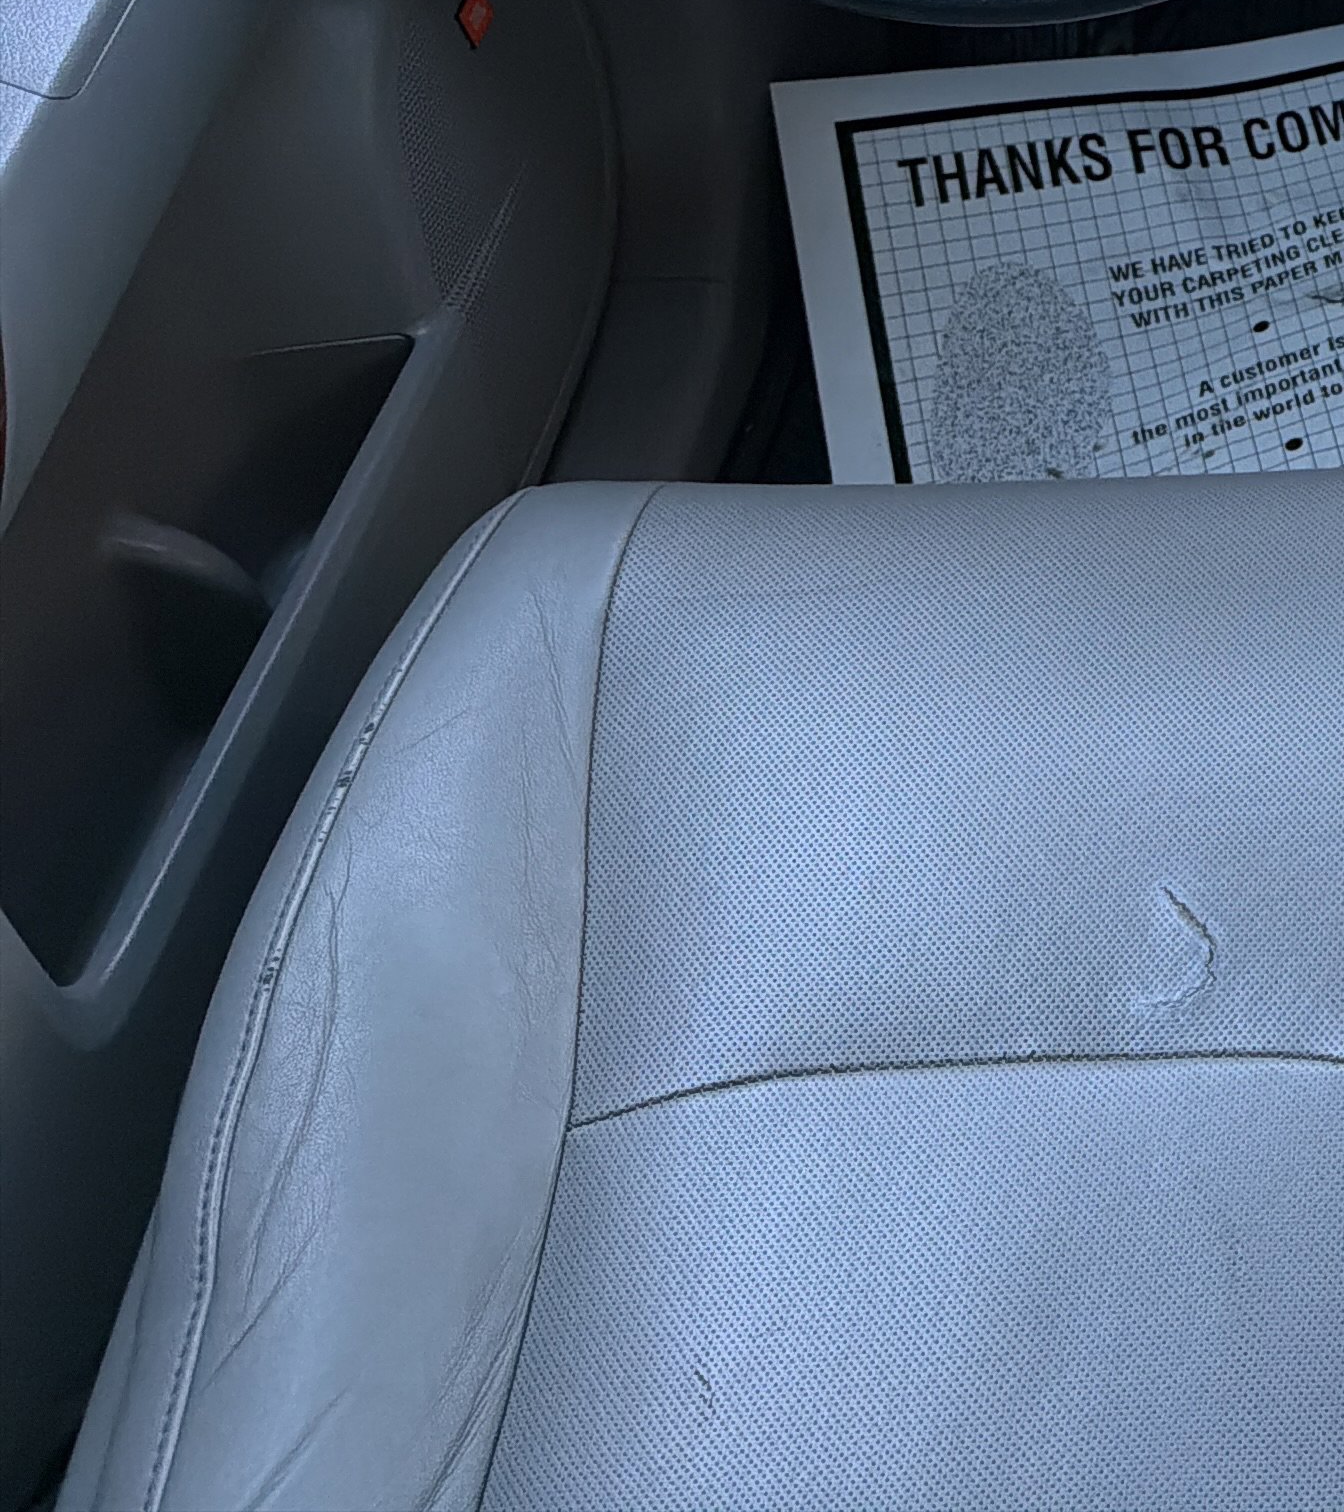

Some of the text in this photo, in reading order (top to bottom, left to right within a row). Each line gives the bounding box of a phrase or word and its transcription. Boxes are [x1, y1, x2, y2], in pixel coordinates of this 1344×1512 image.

[898, 131, 1113, 208] THANKS
[1127, 124, 1230, 175] FOR
[1109, 260, 1145, 283] WE
[1150, 247, 1208, 276] HAVE
[1211, 233, 1275, 264] TRIED
[1278, 220, 1308, 240] TO
[1112, 282, 1176, 308] YOUR
[1182, 246, 1300, 294] CARPETING
[1130, 298, 1190, 329] WITH
[1199, 286, 1245, 315] THIS
[1251, 260, 1318, 294] PAPER
[1132, 423, 1168, 446] the
[1174, 398, 1229, 432] most
[1235, 358, 1343, 408] important
[1199, 380, 1215, 398] A
[1220, 342, 1321, 388] customer
[1184, 434, 1205, 448] in
[1210, 416, 1246, 437] the
[1253, 392, 1316, 422] world
[1320, 382, 1344, 399] to
